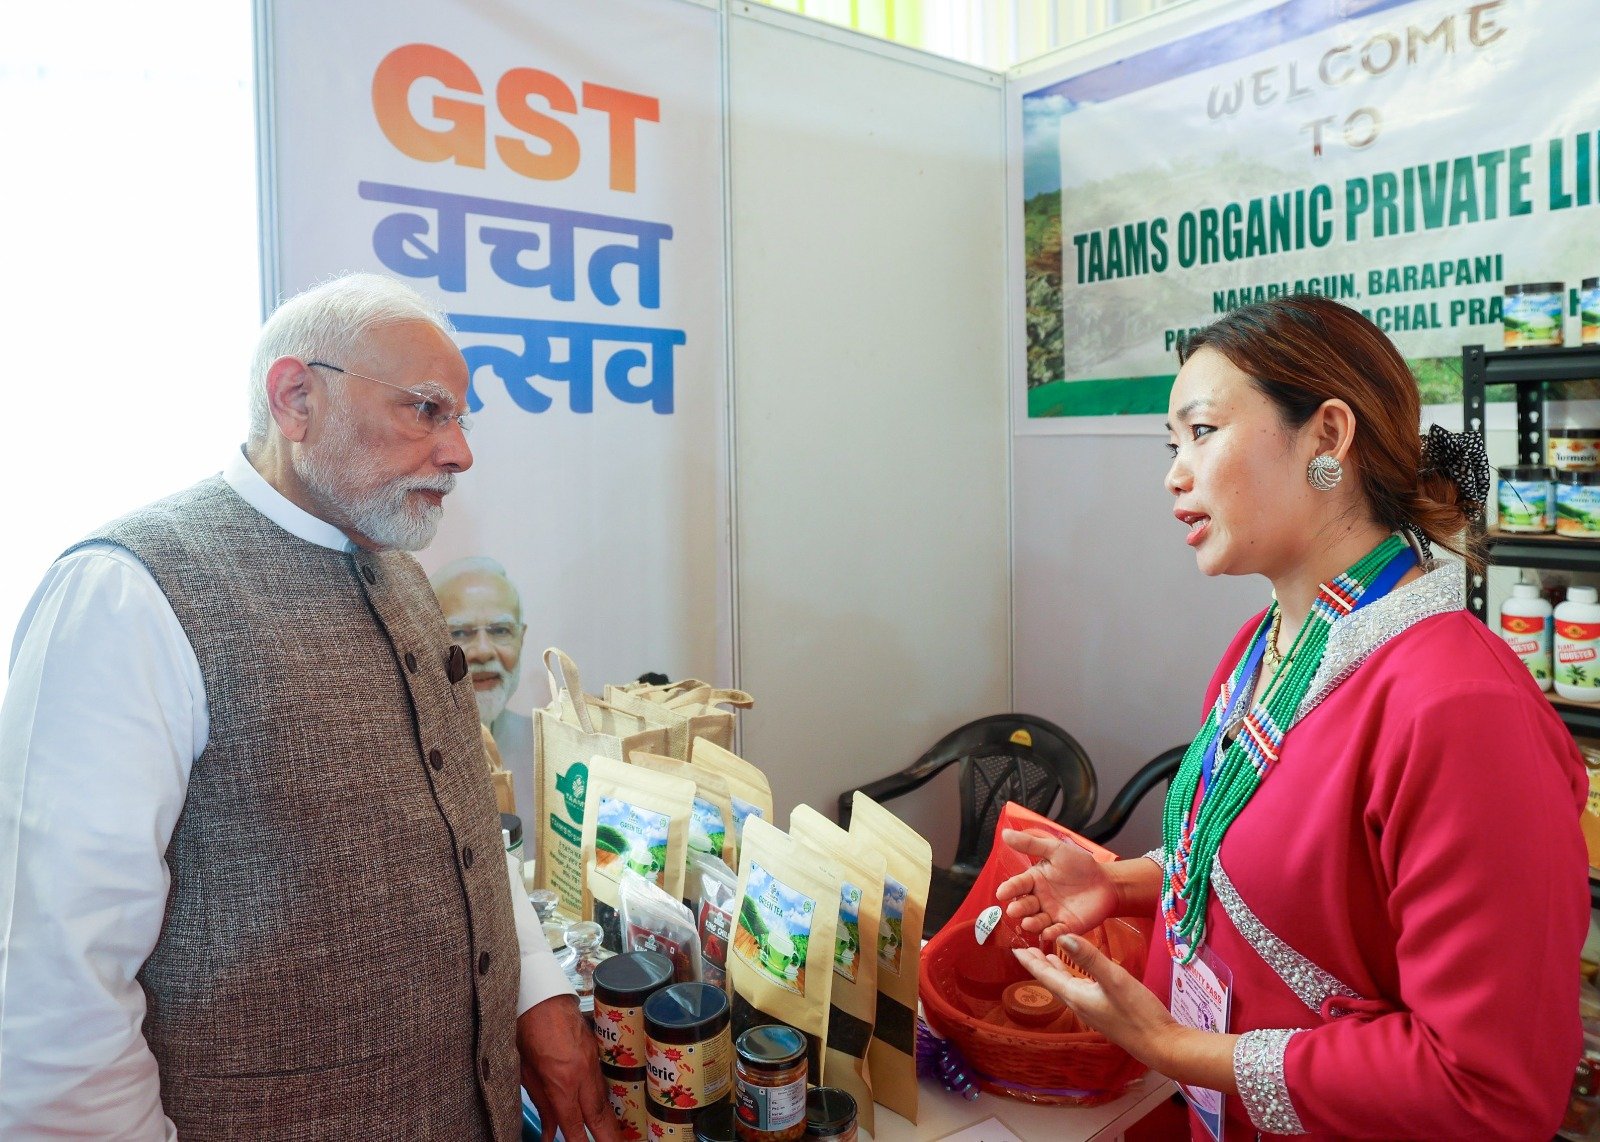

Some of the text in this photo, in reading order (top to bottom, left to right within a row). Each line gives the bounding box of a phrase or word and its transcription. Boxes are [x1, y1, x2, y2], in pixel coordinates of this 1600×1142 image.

[1206, 0, 1509, 120] WELCOME
[371, 43, 661, 194] GST
[1300, 106, 1383, 156] TO
[358, 180, 674, 309] बचत
[1073, 129, 1600, 284] TAAMS ORGANIC PRIVATE LI
[1367, 253, 1503, 296] BARAPANI
[447, 312, 686, 415] त्सव
[619, 821, 635, 832] GREEN
[635, 826, 643, 835] TEA
[758, 895, 773, 911] GREEN
[773, 905, 784, 918] TEA
[1205, 982, 1223, 1004] PASS
